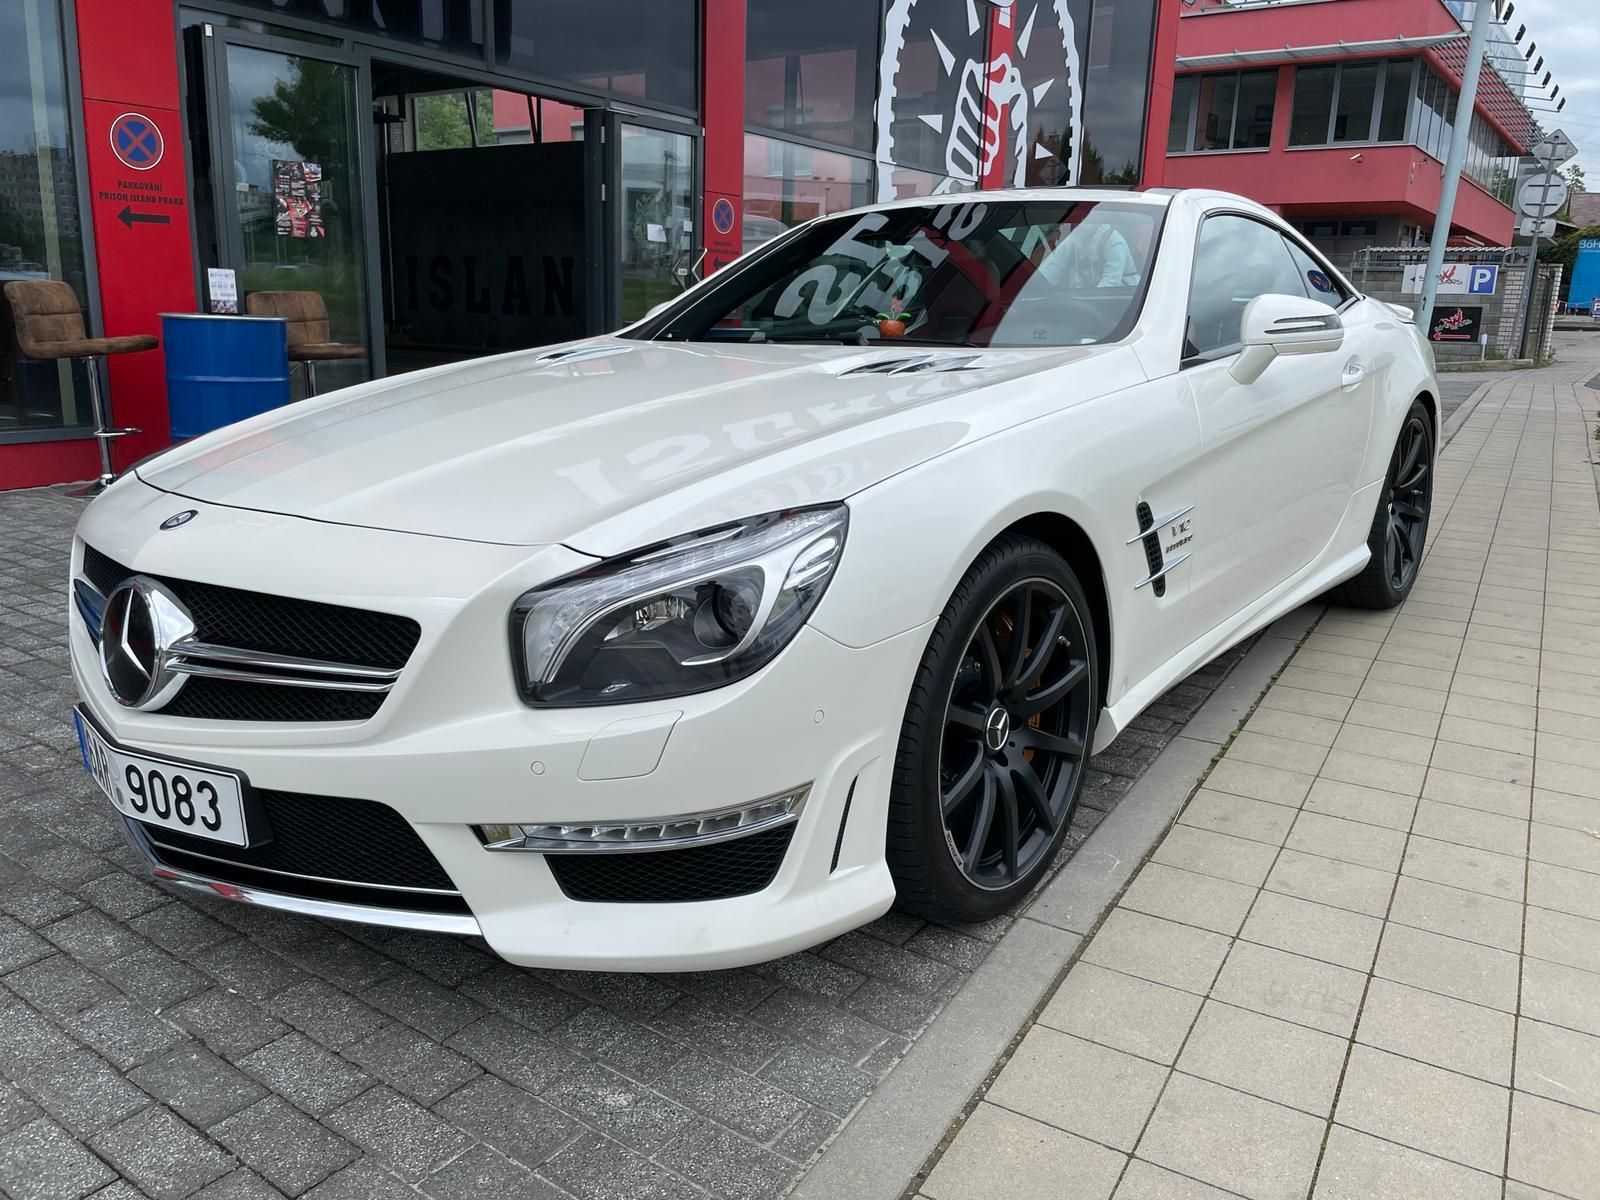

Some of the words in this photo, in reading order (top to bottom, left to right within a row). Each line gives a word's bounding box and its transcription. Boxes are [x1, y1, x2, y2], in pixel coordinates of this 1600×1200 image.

[99, 191, 128, 201] PRISON
[130, 193, 157, 204] ISLAND
[158, 196, 184, 206] PRAHA
[1473, 268, 1491, 291] P
[1171, 519, 1191, 538] V12
[125, 763, 222, 832] 9083
